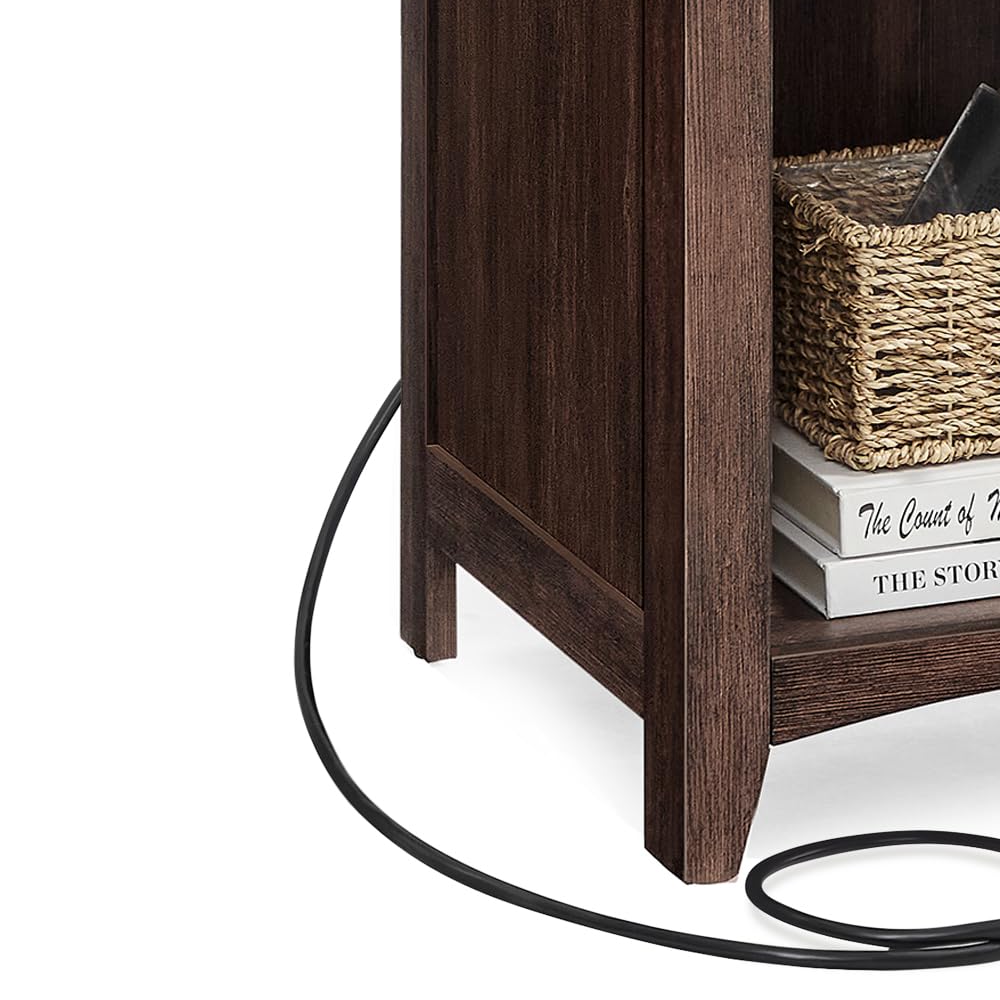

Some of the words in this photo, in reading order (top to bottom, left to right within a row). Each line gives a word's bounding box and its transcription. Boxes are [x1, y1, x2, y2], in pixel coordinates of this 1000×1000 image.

[858, 502, 892, 540] The
[898, 497, 953, 540] Count
[957, 492, 976, 536] of
[872, 569, 927, 595] THE
